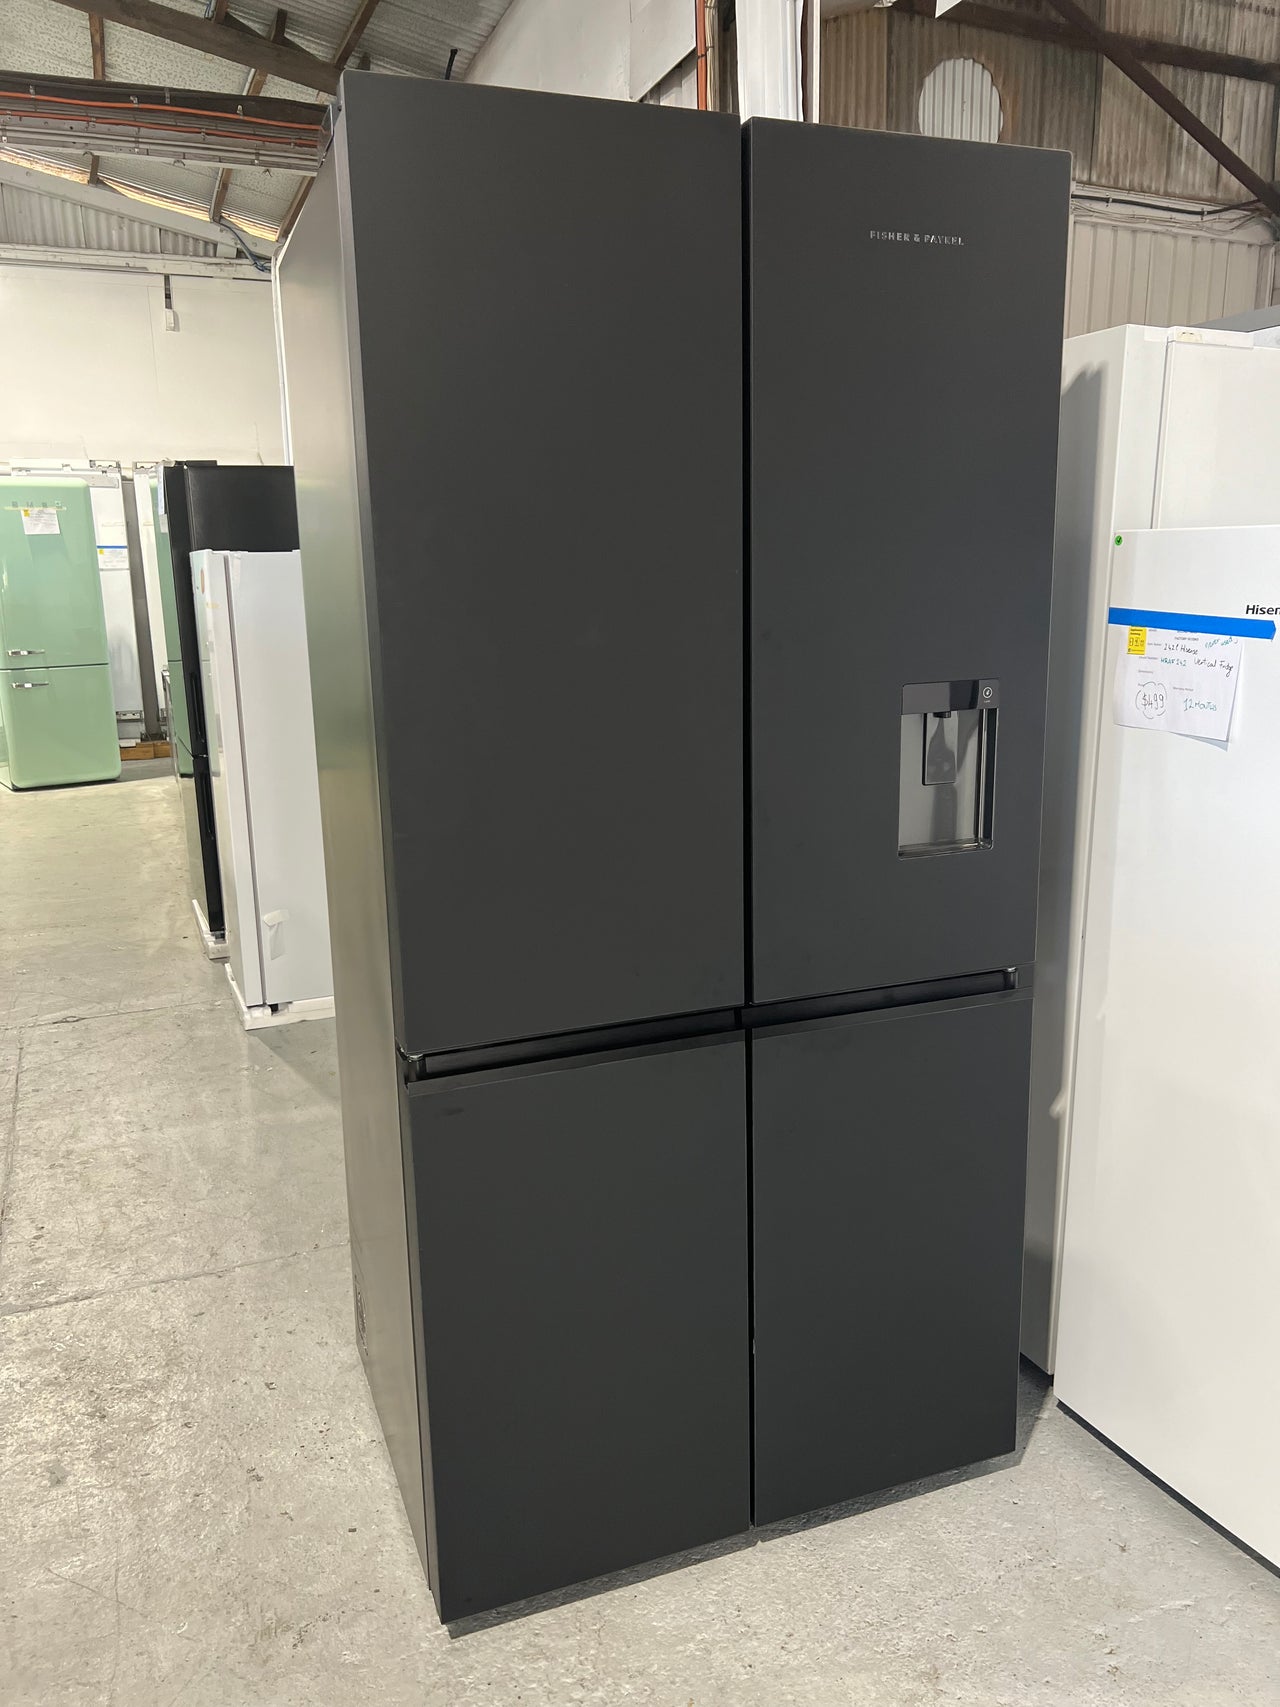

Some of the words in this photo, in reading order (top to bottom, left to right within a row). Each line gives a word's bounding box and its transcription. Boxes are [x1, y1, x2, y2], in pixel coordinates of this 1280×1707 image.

[870, 230, 910, 241] FISHER
[914, 233, 920, 242] &
[924, 234, 964, 245] PAYKEL
[1141, 692, 1164, 711] $499
